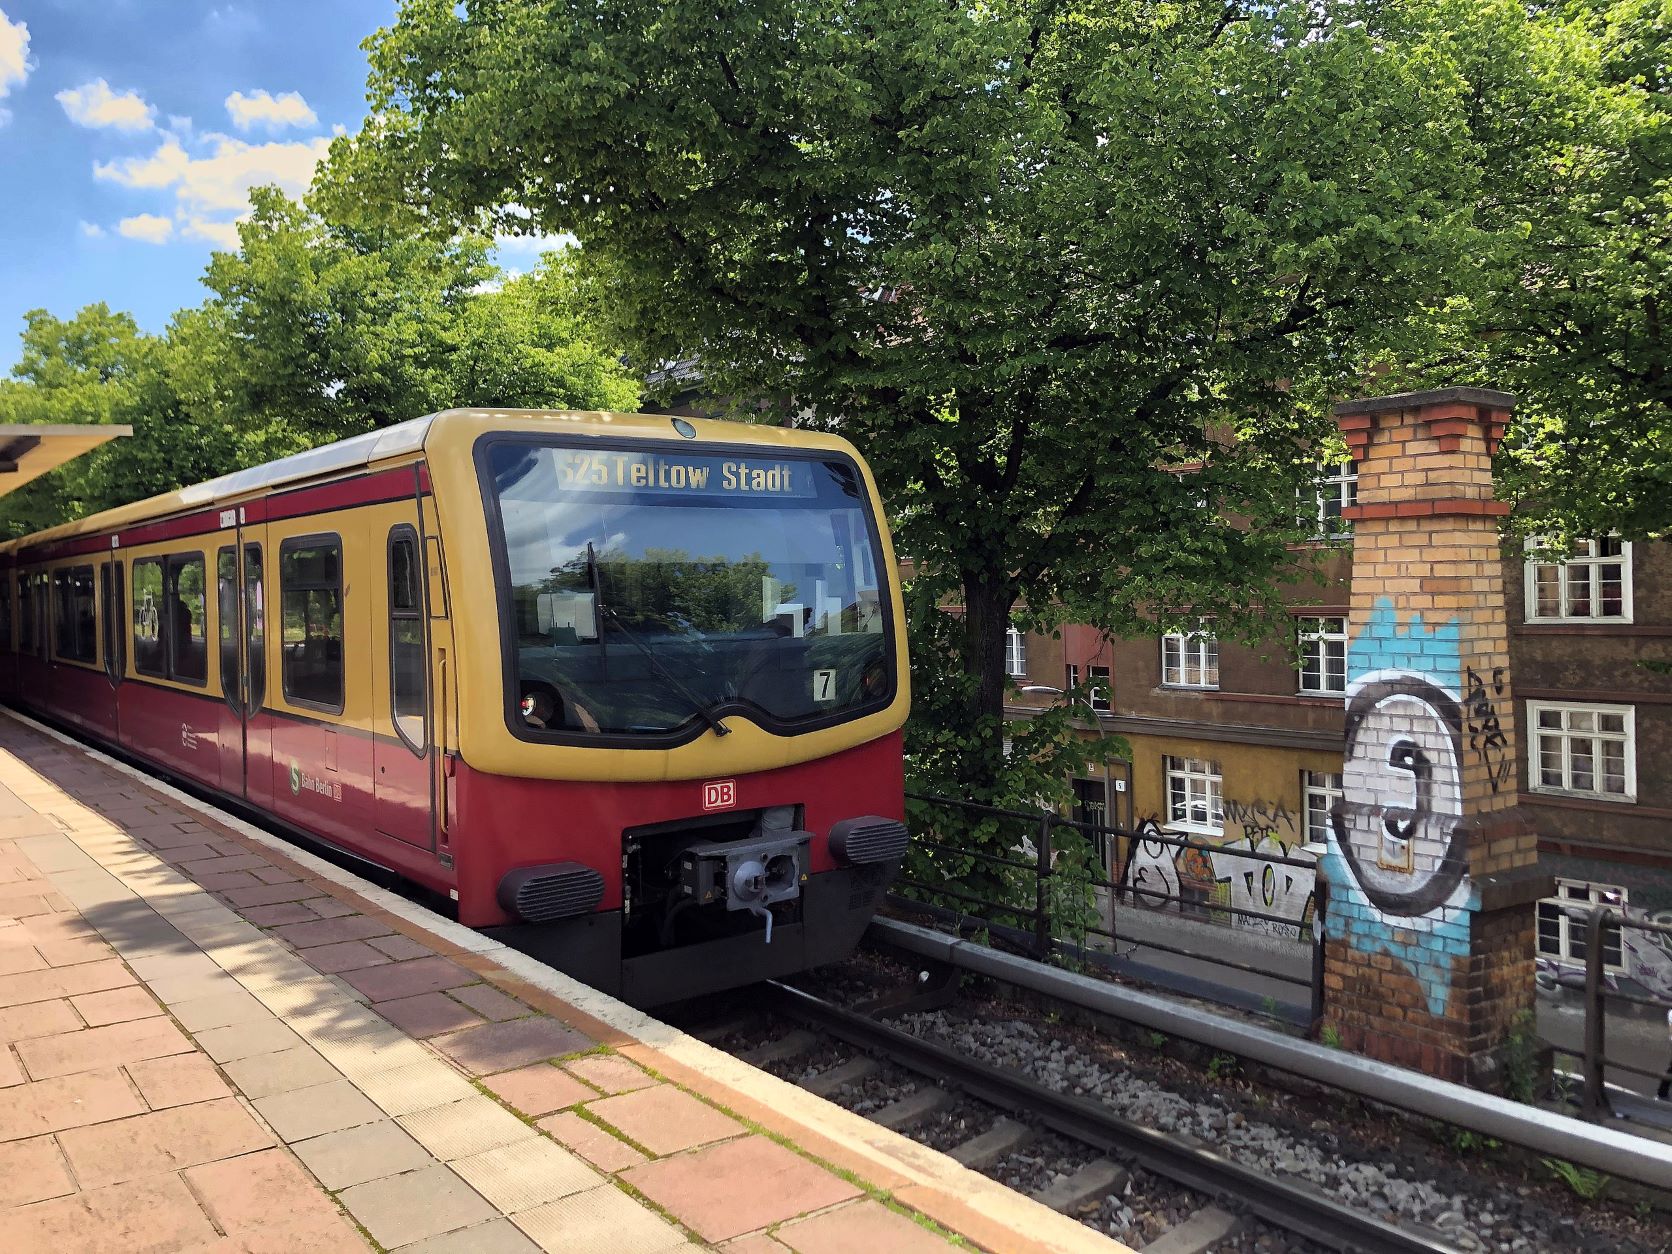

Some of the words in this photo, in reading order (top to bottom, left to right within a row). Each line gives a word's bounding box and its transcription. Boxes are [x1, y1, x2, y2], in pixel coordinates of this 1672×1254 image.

[612, 456, 709, 488] Teltow
[723, 462, 792, 491] Stadt
[819, 671, 830, 699] 7
[315, 777, 332, 798] Berlin
[706, 783, 733, 806] DB
